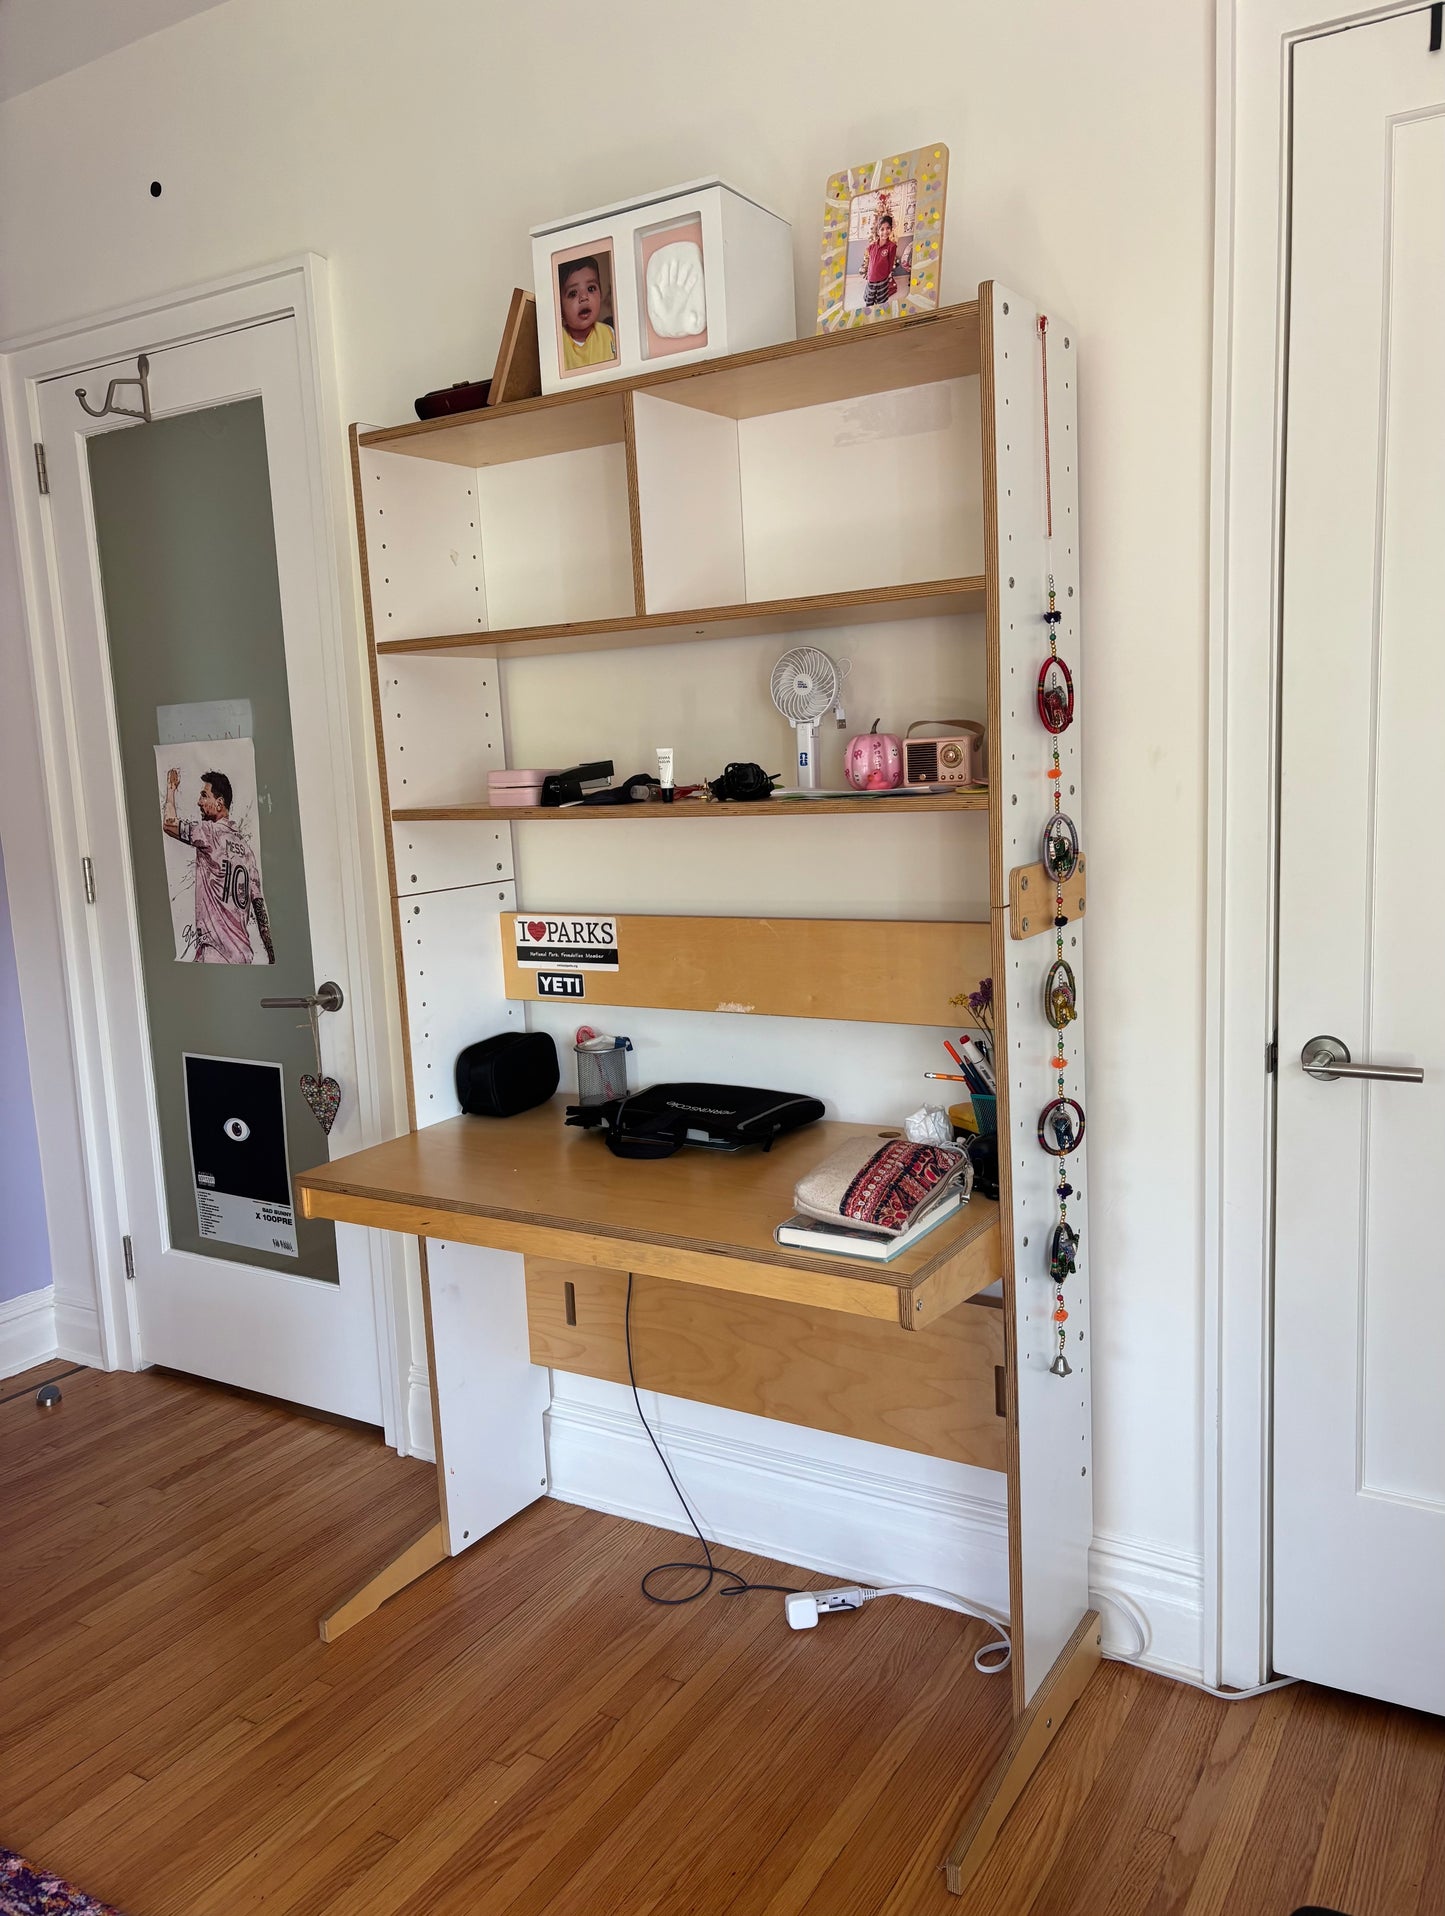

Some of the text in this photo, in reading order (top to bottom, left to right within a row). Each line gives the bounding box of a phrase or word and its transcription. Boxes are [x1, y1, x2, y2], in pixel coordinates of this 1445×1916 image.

[221, 859, 250, 909] 10
[518, 921, 614, 945] I PARKS
[539, 976, 581, 993] YETI
[263, 1214, 292, 1226] 100PRE
[274, 1209, 291, 1217] BUNNY
